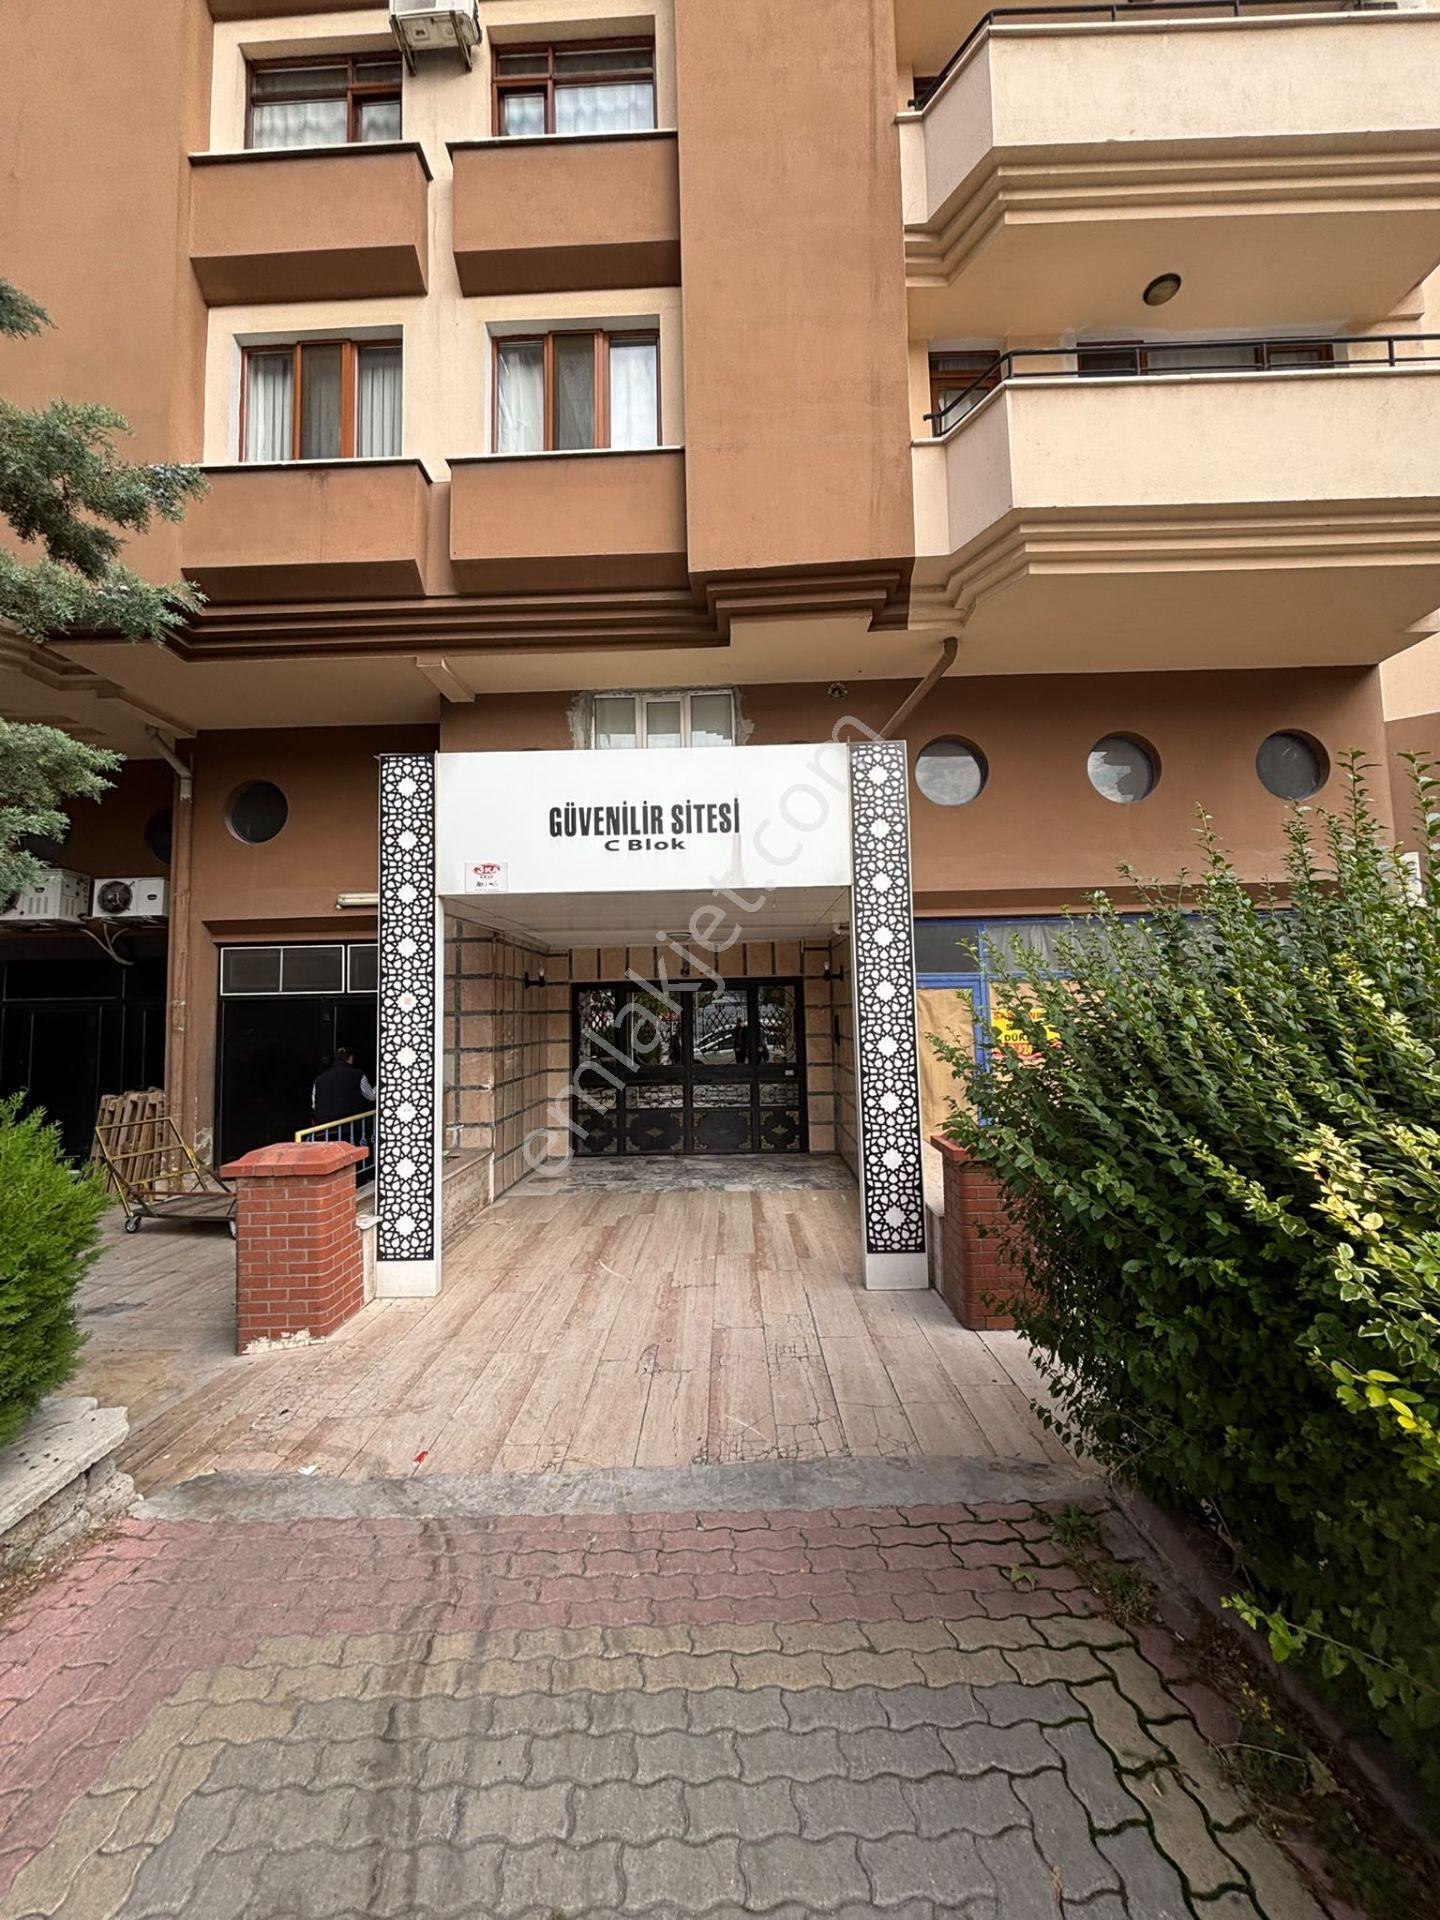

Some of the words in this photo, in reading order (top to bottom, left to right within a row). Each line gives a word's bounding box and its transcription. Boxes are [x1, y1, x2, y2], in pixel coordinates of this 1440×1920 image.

[550, 800, 664, 838] GÜVENİLİR
[671, 797, 740, 835] SİTESİ
[605, 839, 620, 852] C
[628, 838, 686, 851] Blok
